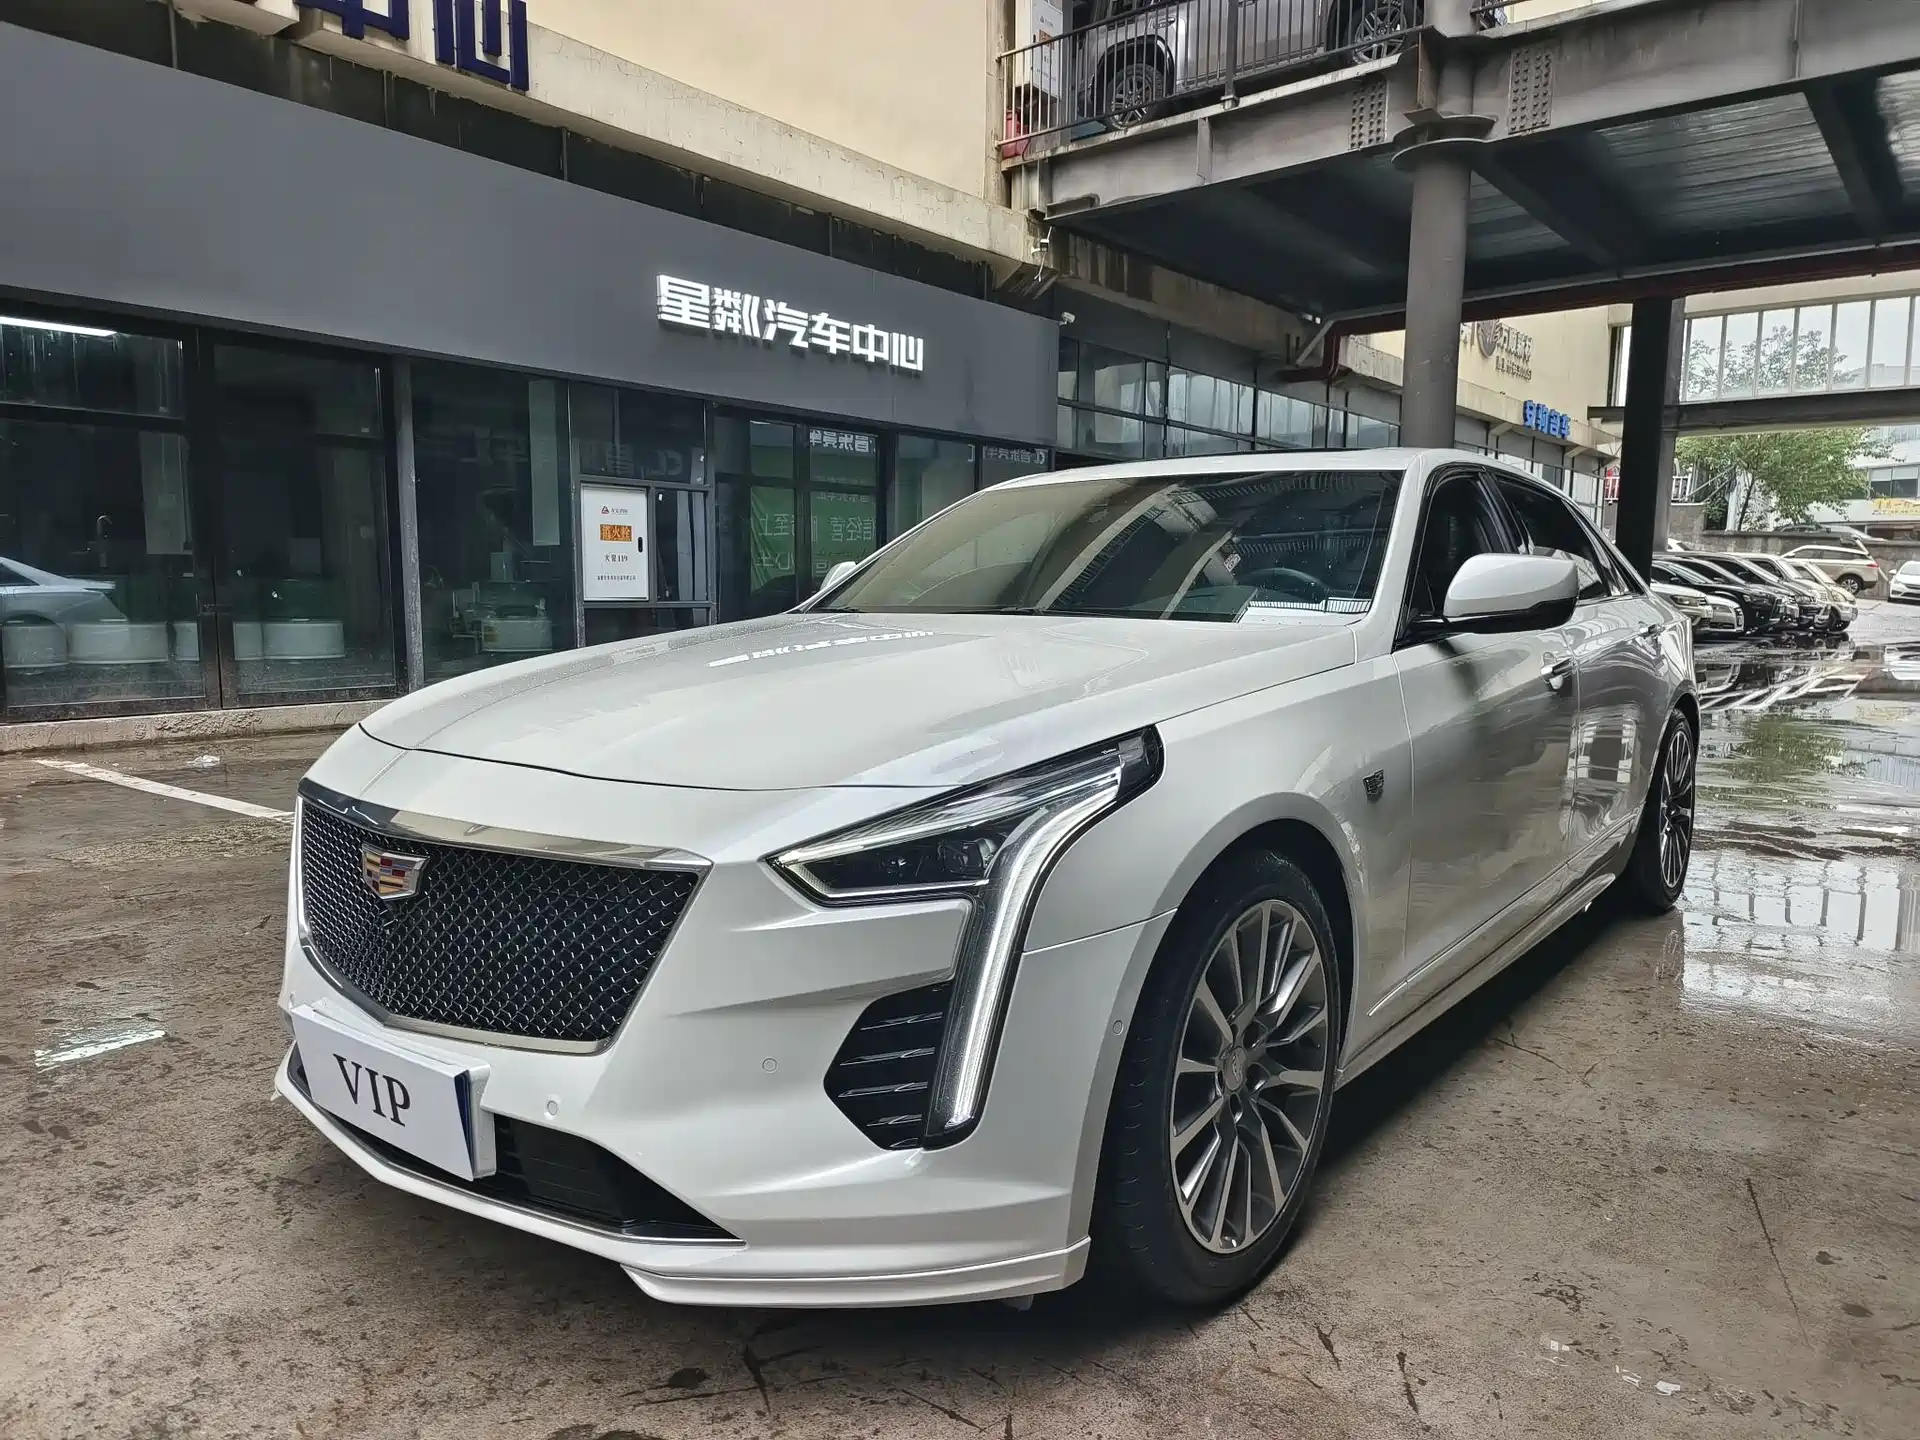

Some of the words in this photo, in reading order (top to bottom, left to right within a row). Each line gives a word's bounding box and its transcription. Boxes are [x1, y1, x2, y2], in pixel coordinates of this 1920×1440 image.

[656, 274, 924, 371] 星粼汽车中心
[332, 1053, 411, 1127] VIP
